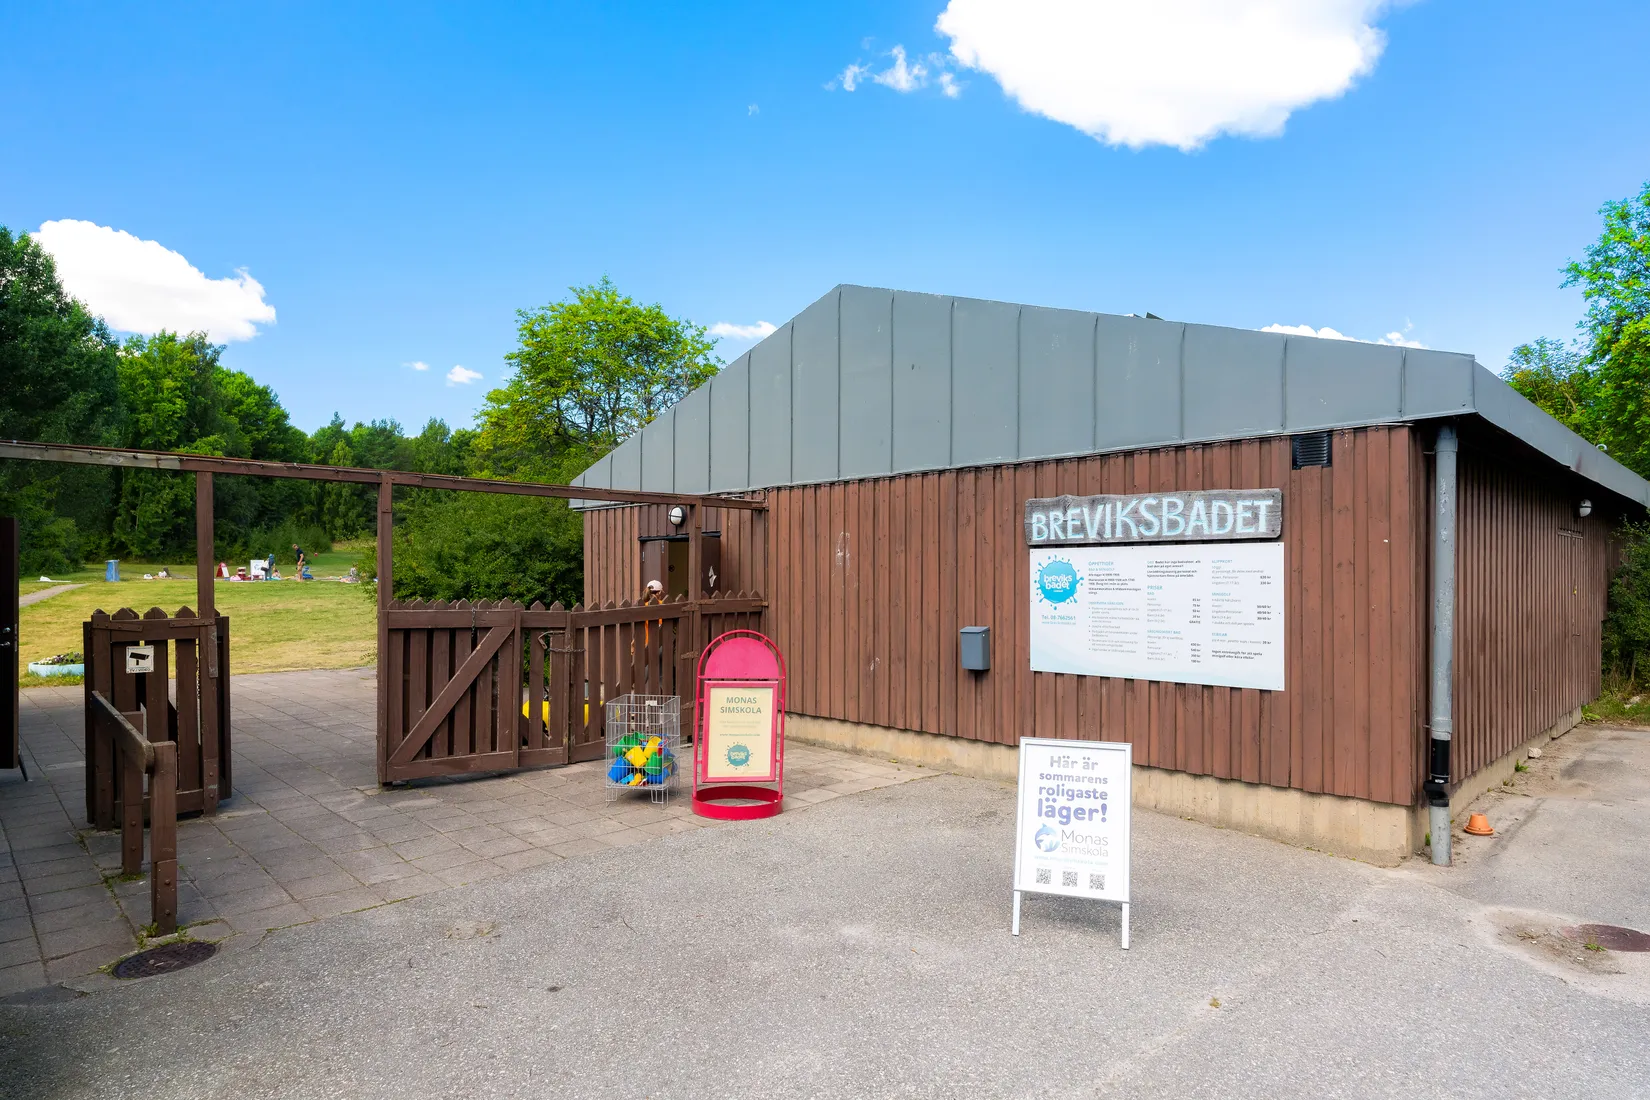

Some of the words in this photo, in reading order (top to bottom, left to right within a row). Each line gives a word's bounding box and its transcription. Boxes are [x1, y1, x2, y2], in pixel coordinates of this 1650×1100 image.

[1032, 497, 1274, 540] BREVIKSBADET
[1044, 574, 1072, 583] breviks
[1046, 579, 1070, 590] badet
[1050, 756, 1078, 768] Här
[1082, 756, 1098, 770] är
[1039, 772, 1108, 784] sommarens
[1039, 784, 1108, 801] roligaste
[1038, 797, 1107, 826] läger!
[1061, 829, 1109, 846] Monas
[1061, 842, 1108, 857] Simskola
